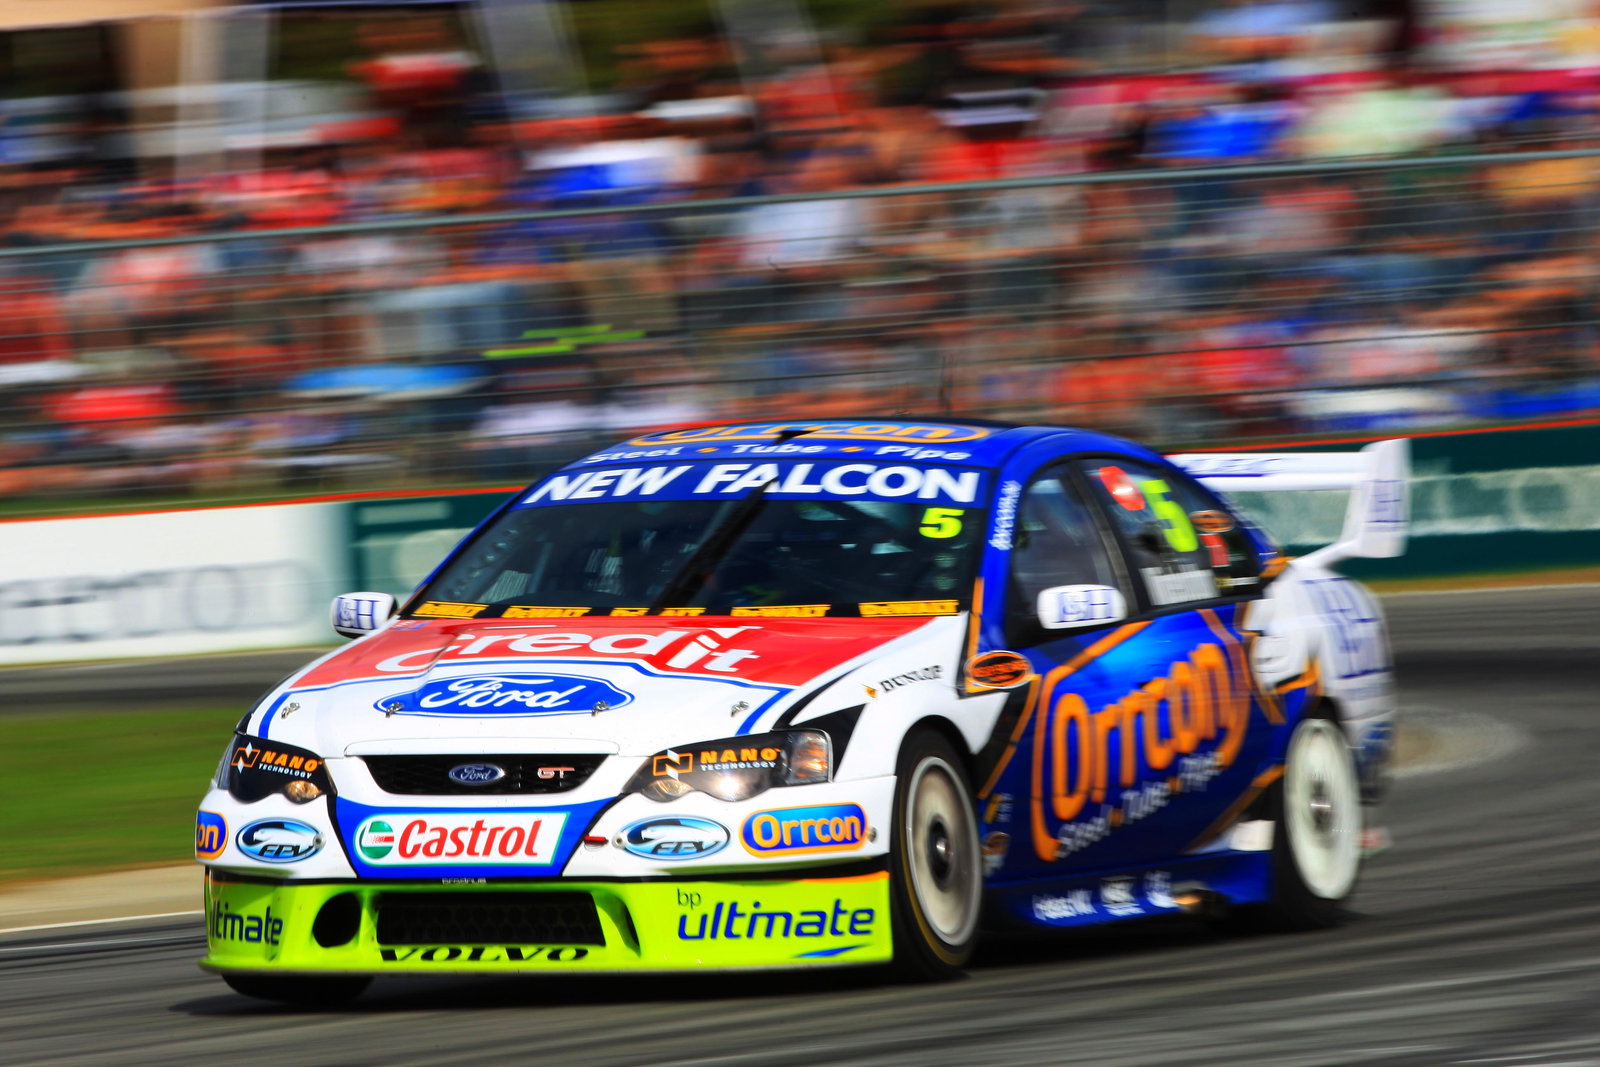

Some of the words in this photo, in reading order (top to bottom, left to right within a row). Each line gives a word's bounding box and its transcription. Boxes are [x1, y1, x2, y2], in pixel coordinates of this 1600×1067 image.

[582, 446, 684, 463] Steel
[732, 444, 827, 454] Tube
[875, 445, 972, 460] Pipe
[523, 465, 694, 503] NEW
[694, 463, 980, 503] FALCON
[919, 507, 964, 539] 5
[1139, 479, 1199, 552] 5
[880, 665, 943, 692] DUNLOP
[420, 678, 586, 708] Ford
[1052, 643, 1234, 820] Orrcon
[261, 750, 318, 772] NANO
[700, 747, 777, 764] NANO
[700, 761, 776, 772] TECHNOLOGY
[258, 763, 312, 779] TECHNOLOGY
[461, 764, 491, 782] Ford
[537, 766, 575, 779] GT
[398, 819, 543, 859] Castrol
[752, 813, 862, 849] Orrcon
[677, 888, 702, 909] bp
[678, 898, 875, 941] ultimate
[380, 947, 589, 961] VOLVO
